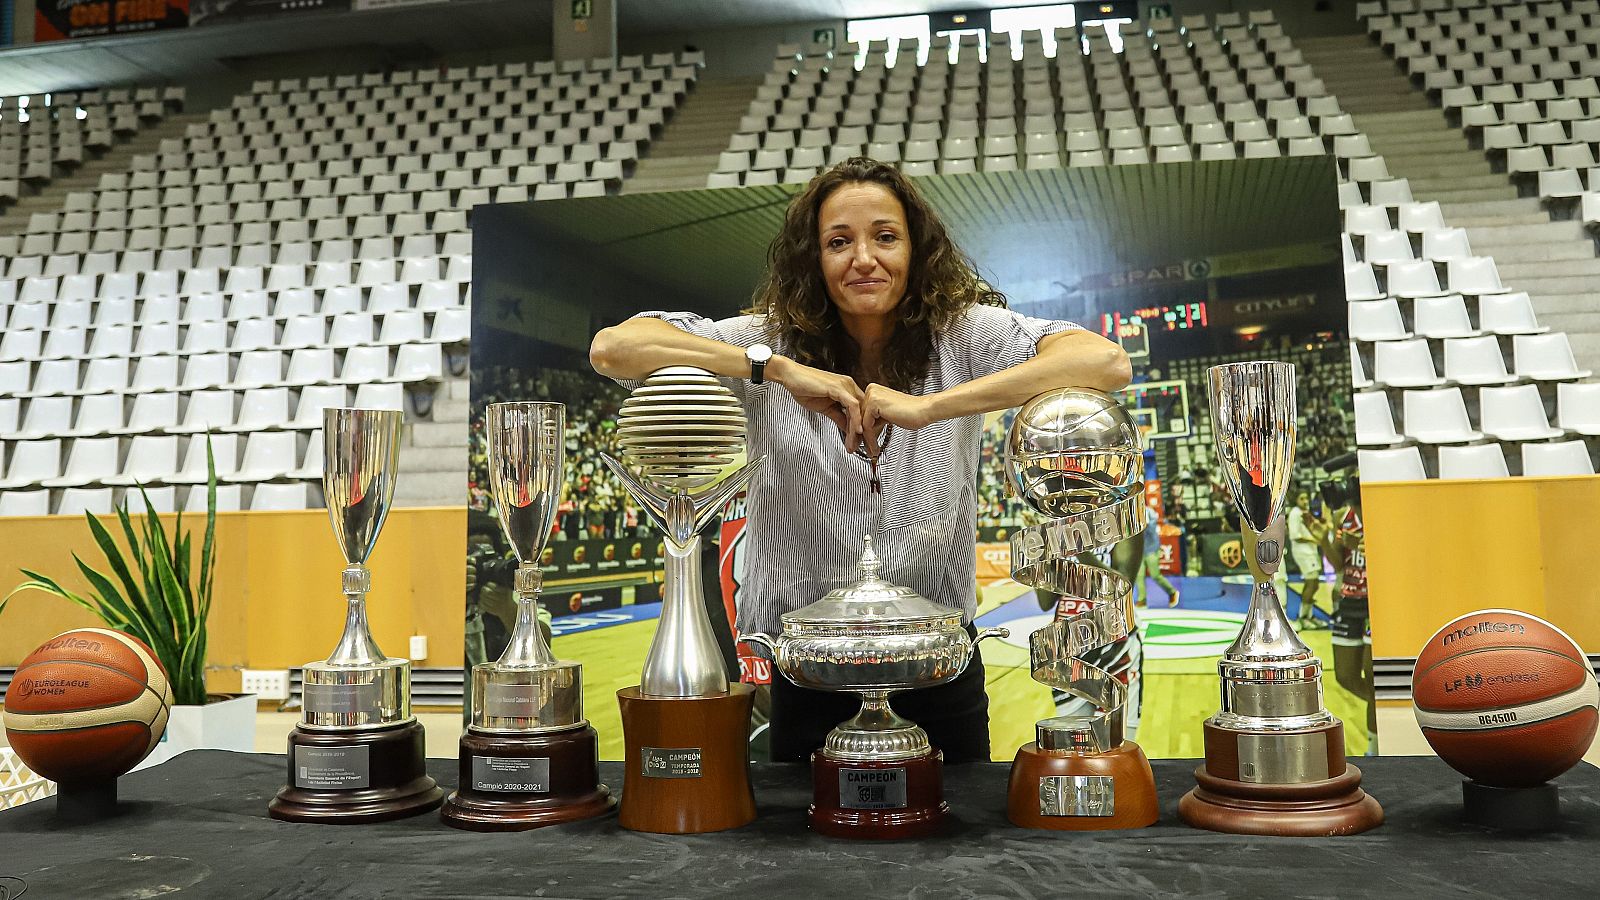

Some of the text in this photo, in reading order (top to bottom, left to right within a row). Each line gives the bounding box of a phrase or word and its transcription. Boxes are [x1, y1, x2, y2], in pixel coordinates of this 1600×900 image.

[1111, 264, 1184, 287] SPAR
[1351, 549, 1365, 567] 16
[1442, 621, 1526, 647] molten
[33, 637, 104, 656] molten
[34, 680, 90, 689] EUROLEAGUE
[1444, 672, 1541, 693] LF endesa
[33, 688, 66, 697] WOMEN
[1478, 711, 1518, 725] BG4500
[847, 770, 897, 783] CAMPEÓN
[503, 783, 541, 791] 2020-2021
